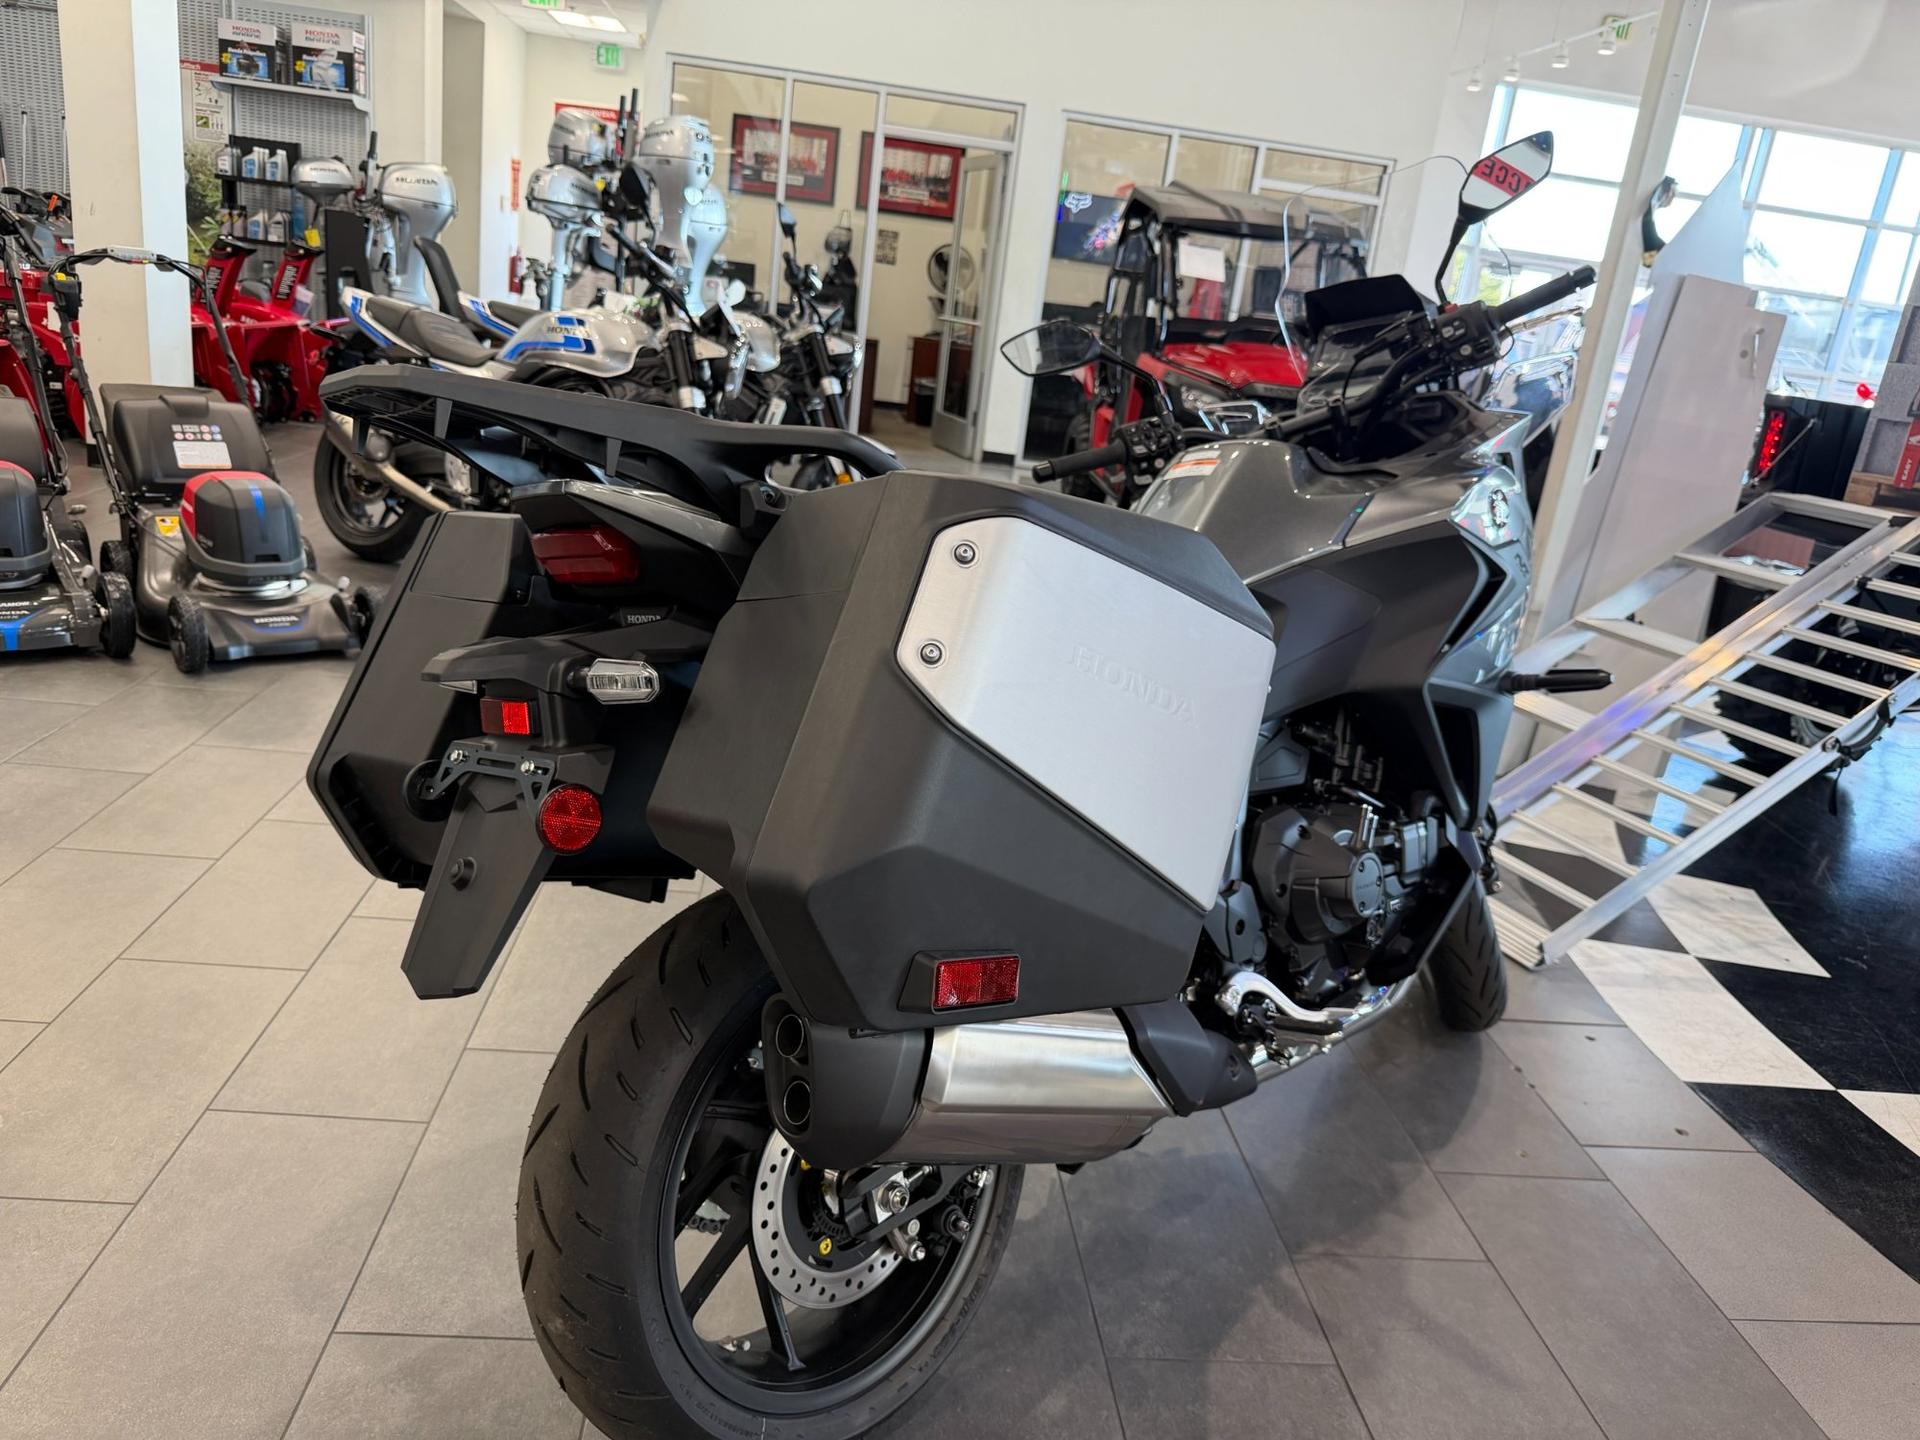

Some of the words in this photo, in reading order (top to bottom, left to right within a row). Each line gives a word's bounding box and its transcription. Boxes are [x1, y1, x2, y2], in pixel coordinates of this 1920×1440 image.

[232, 25, 261, 34] HONDA
[304, 29, 340, 39] HONDA
[596, 44, 621, 66] EXIT
[547, 326, 591, 338] HONDA
[254, 615, 299, 624] HONDA
[1073, 646, 1199, 728] HONDA
